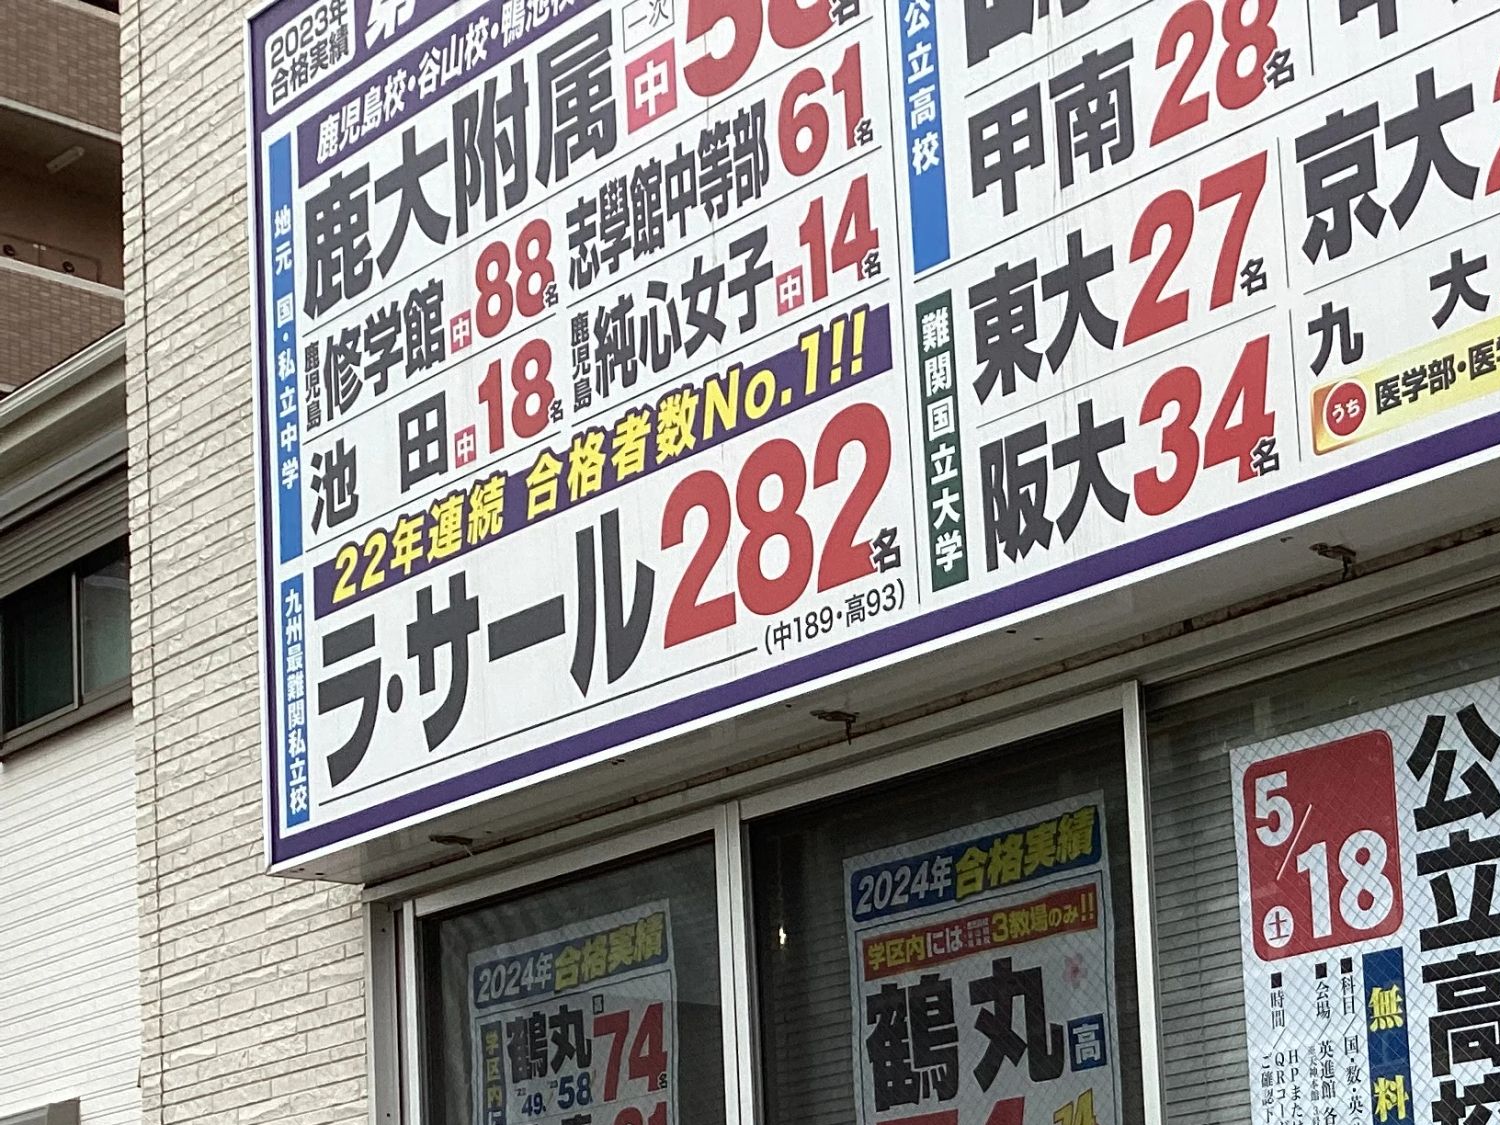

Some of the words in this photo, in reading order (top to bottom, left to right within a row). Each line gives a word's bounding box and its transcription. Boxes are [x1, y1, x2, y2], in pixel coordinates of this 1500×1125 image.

[271, 24, 349, 105] 合格実績
[964, 37, 1138, 217] 甲南
[274, 204, 293, 276] 地元
[303, 9, 619, 320] 鹿大附属
[633, 57, 672, 118] 中
[566, 98, 770, 291] 志學館中等部
[1295, 69, 1482, 264] 京大
[304, 341, 321, 432] 鹿児島
[322, 278, 447, 422] 修学館
[452, 315, 471, 348] 中
[570, 310, 592, 413] 鹿児島
[593, 225, 774, 399] 純心女子
[779, 275, 800, 310] 中
[967, 227, 1119, 404] 東大
[457, 431, 474, 463] 中
[922, 308, 962, 576] 難関国立大学
[979, 400, 1131, 573] 阪大
[1331, 397, 1361, 425] うち
[332, 475, 507, 604] 22年連続
[283, 588, 308, 814] 九州最難関私立校
[317, 506, 655, 788] ラ・サール
[865, 956, 1065, 1113] 鶴丸
[1072, 1022, 1101, 1065] 高
[1367, 983, 1410, 1123] 無料
